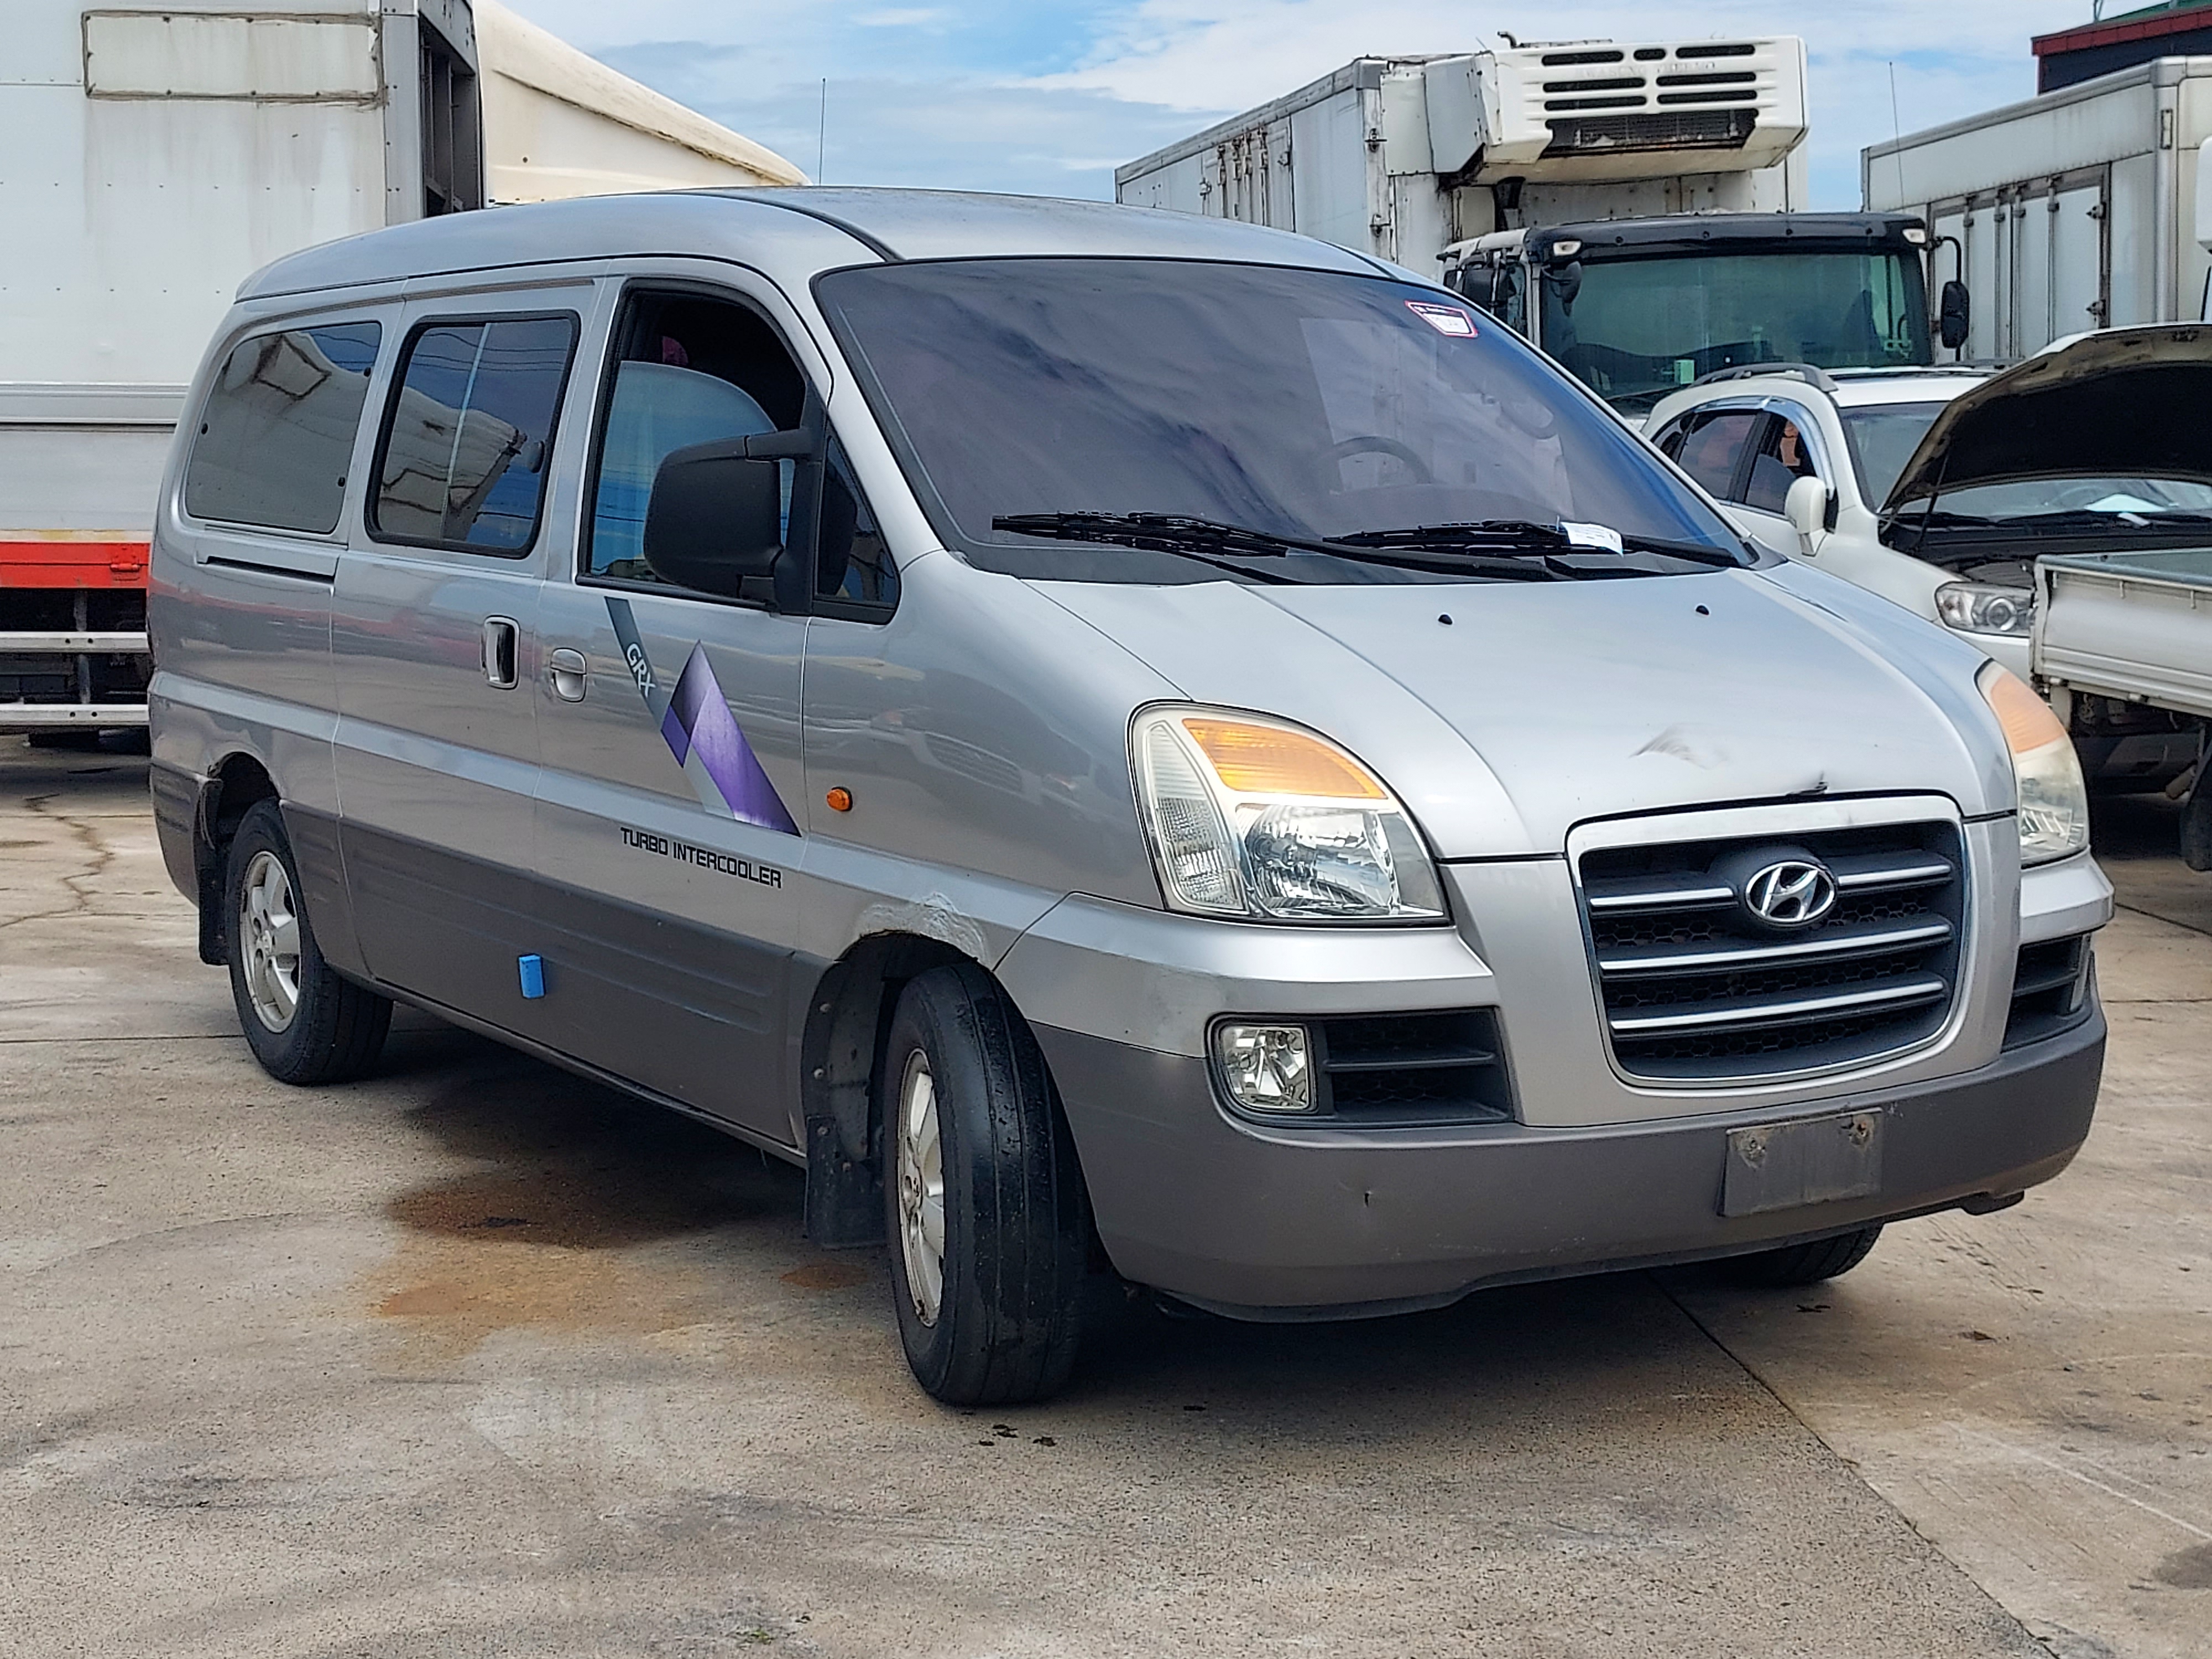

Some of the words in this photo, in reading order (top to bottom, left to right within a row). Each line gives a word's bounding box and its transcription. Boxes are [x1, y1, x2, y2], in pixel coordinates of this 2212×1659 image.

[625, 643, 656, 698] GRX
[620, 826, 668, 856] TURBO
[673, 842, 782, 889] INTERCOOLER
